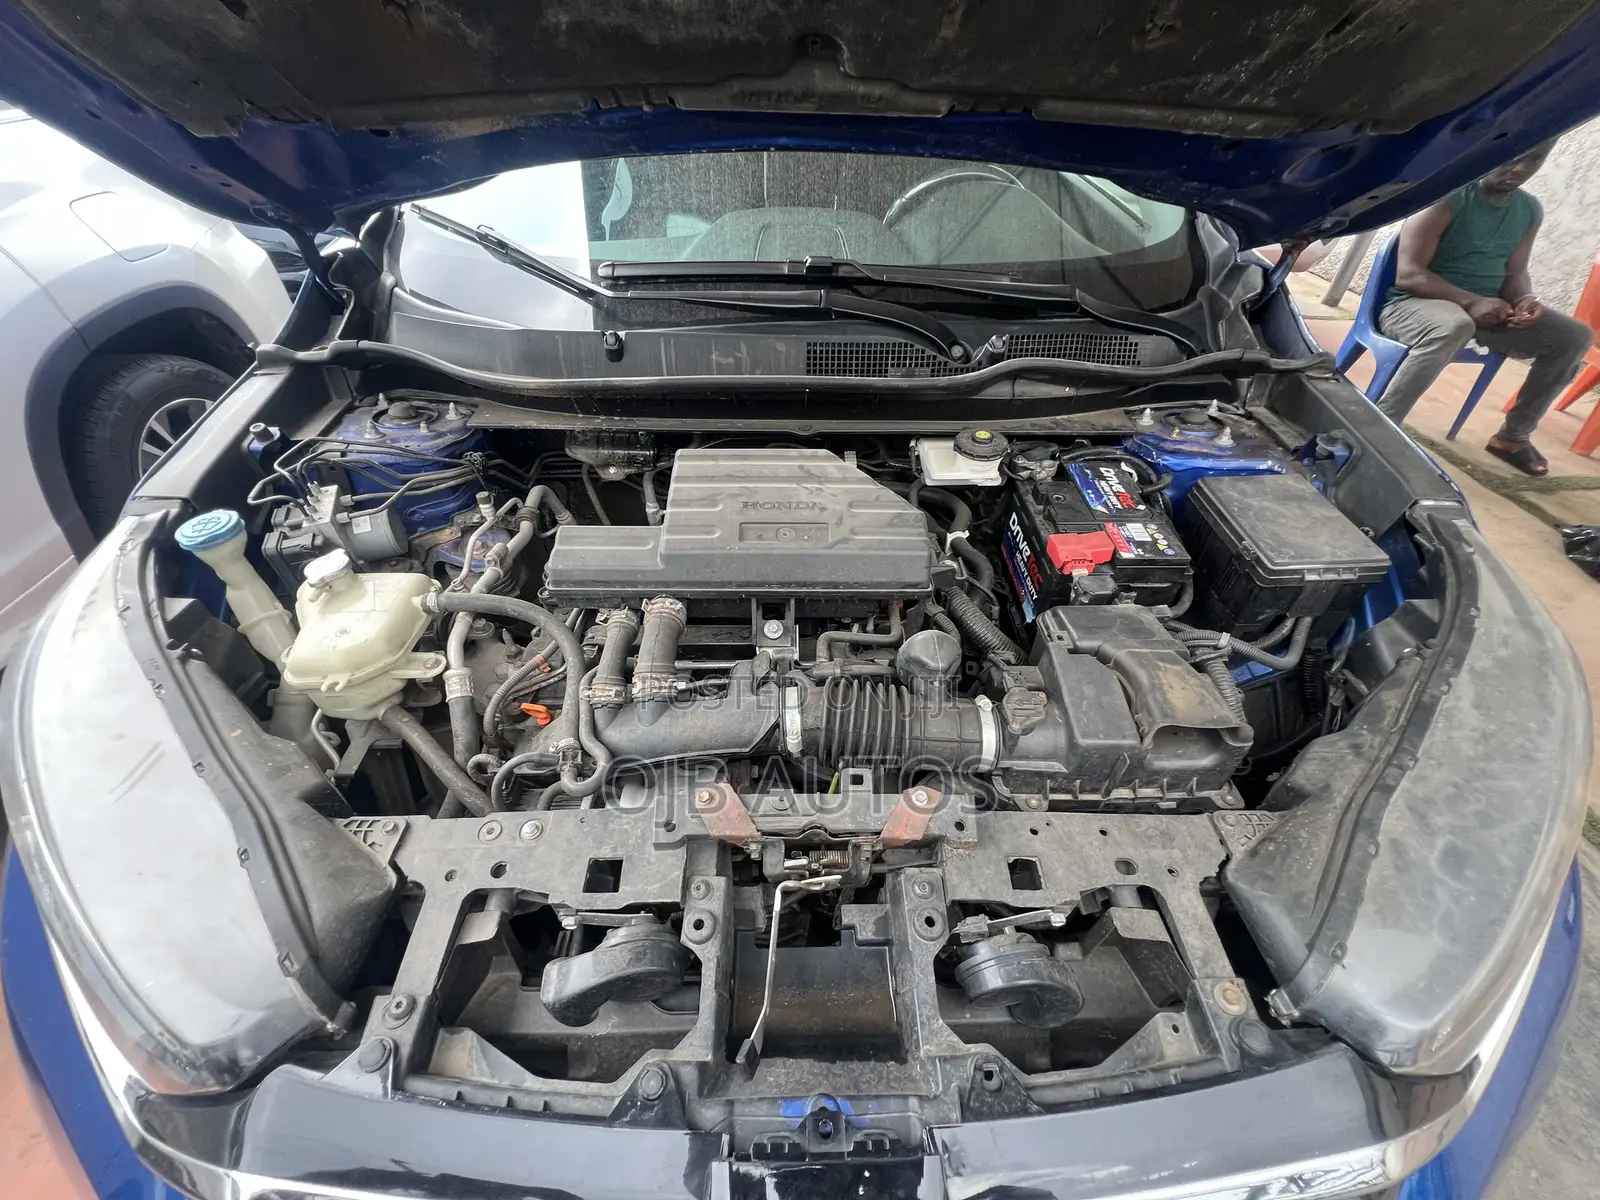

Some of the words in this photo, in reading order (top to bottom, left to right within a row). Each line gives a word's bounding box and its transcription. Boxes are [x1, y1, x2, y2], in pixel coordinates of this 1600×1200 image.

[740, 500, 828, 512] HONDA
[1015, 551, 1029, 578] HEAVY
[1025, 576, 1038, 600] DUTY
